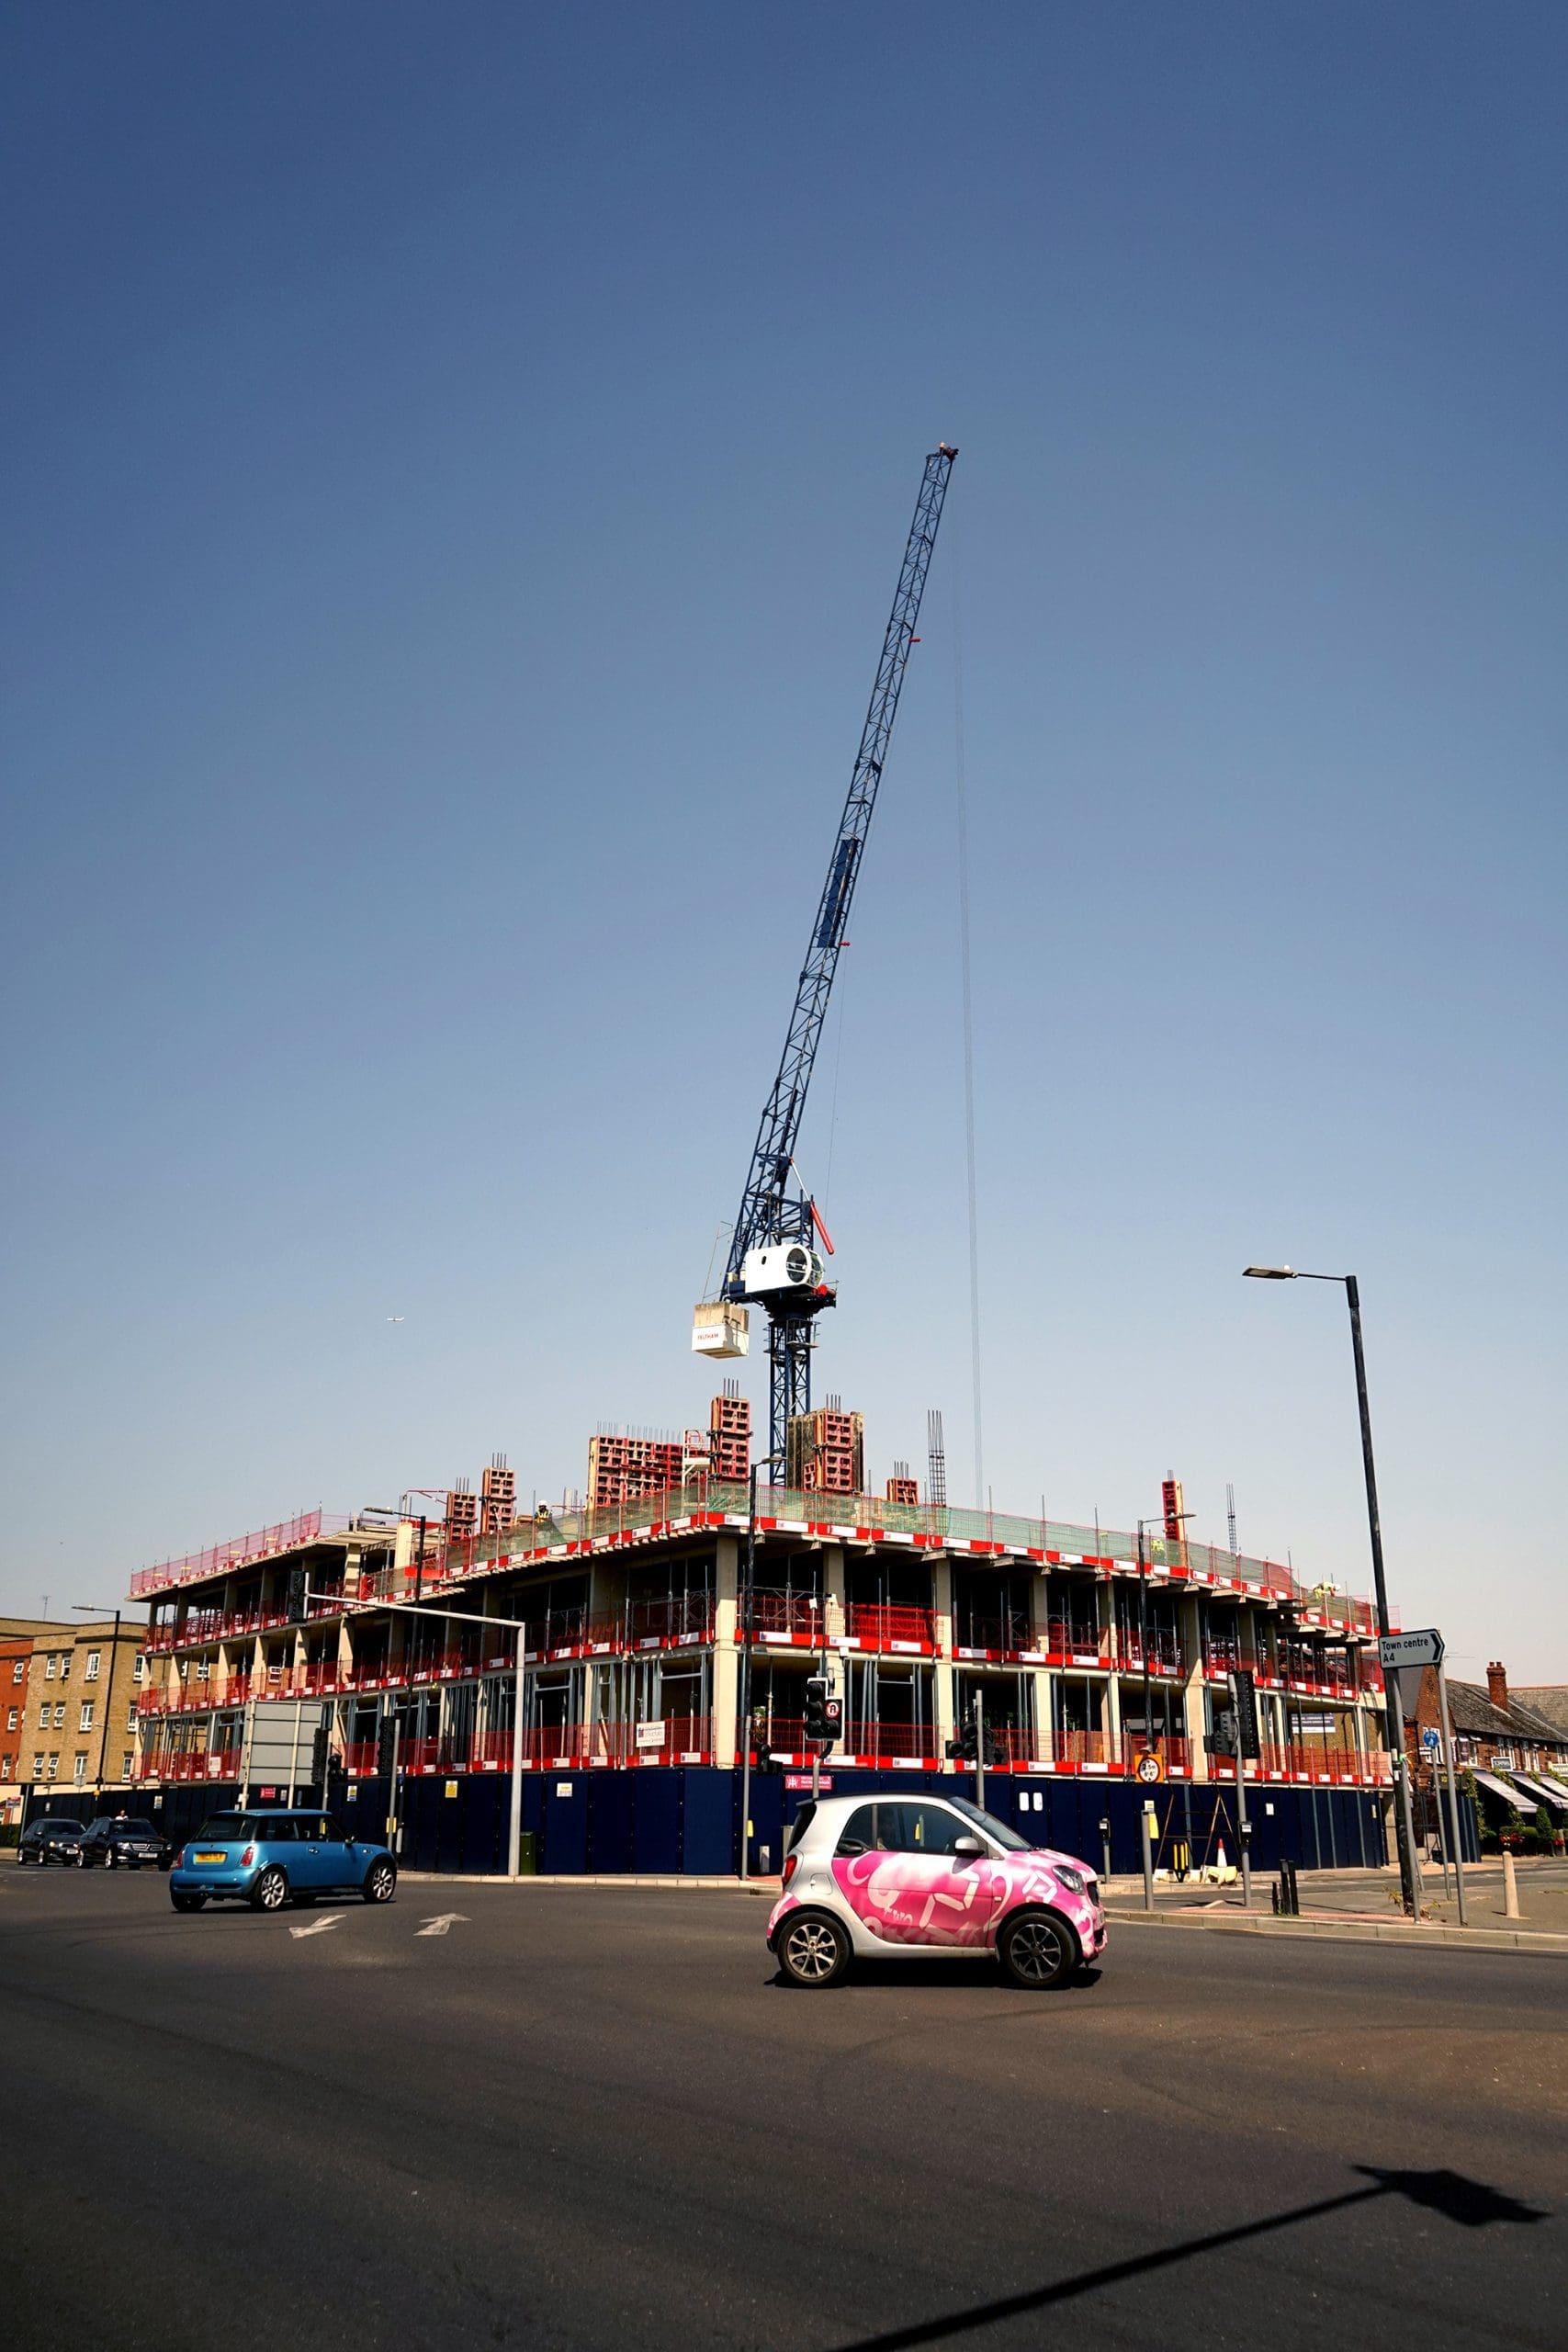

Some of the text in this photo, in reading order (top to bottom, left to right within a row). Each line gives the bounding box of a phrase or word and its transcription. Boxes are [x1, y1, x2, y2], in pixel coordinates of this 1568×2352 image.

[1382, 1637, 1428, 1651] Town centre
[1382, 1653, 1395, 1663] A4
